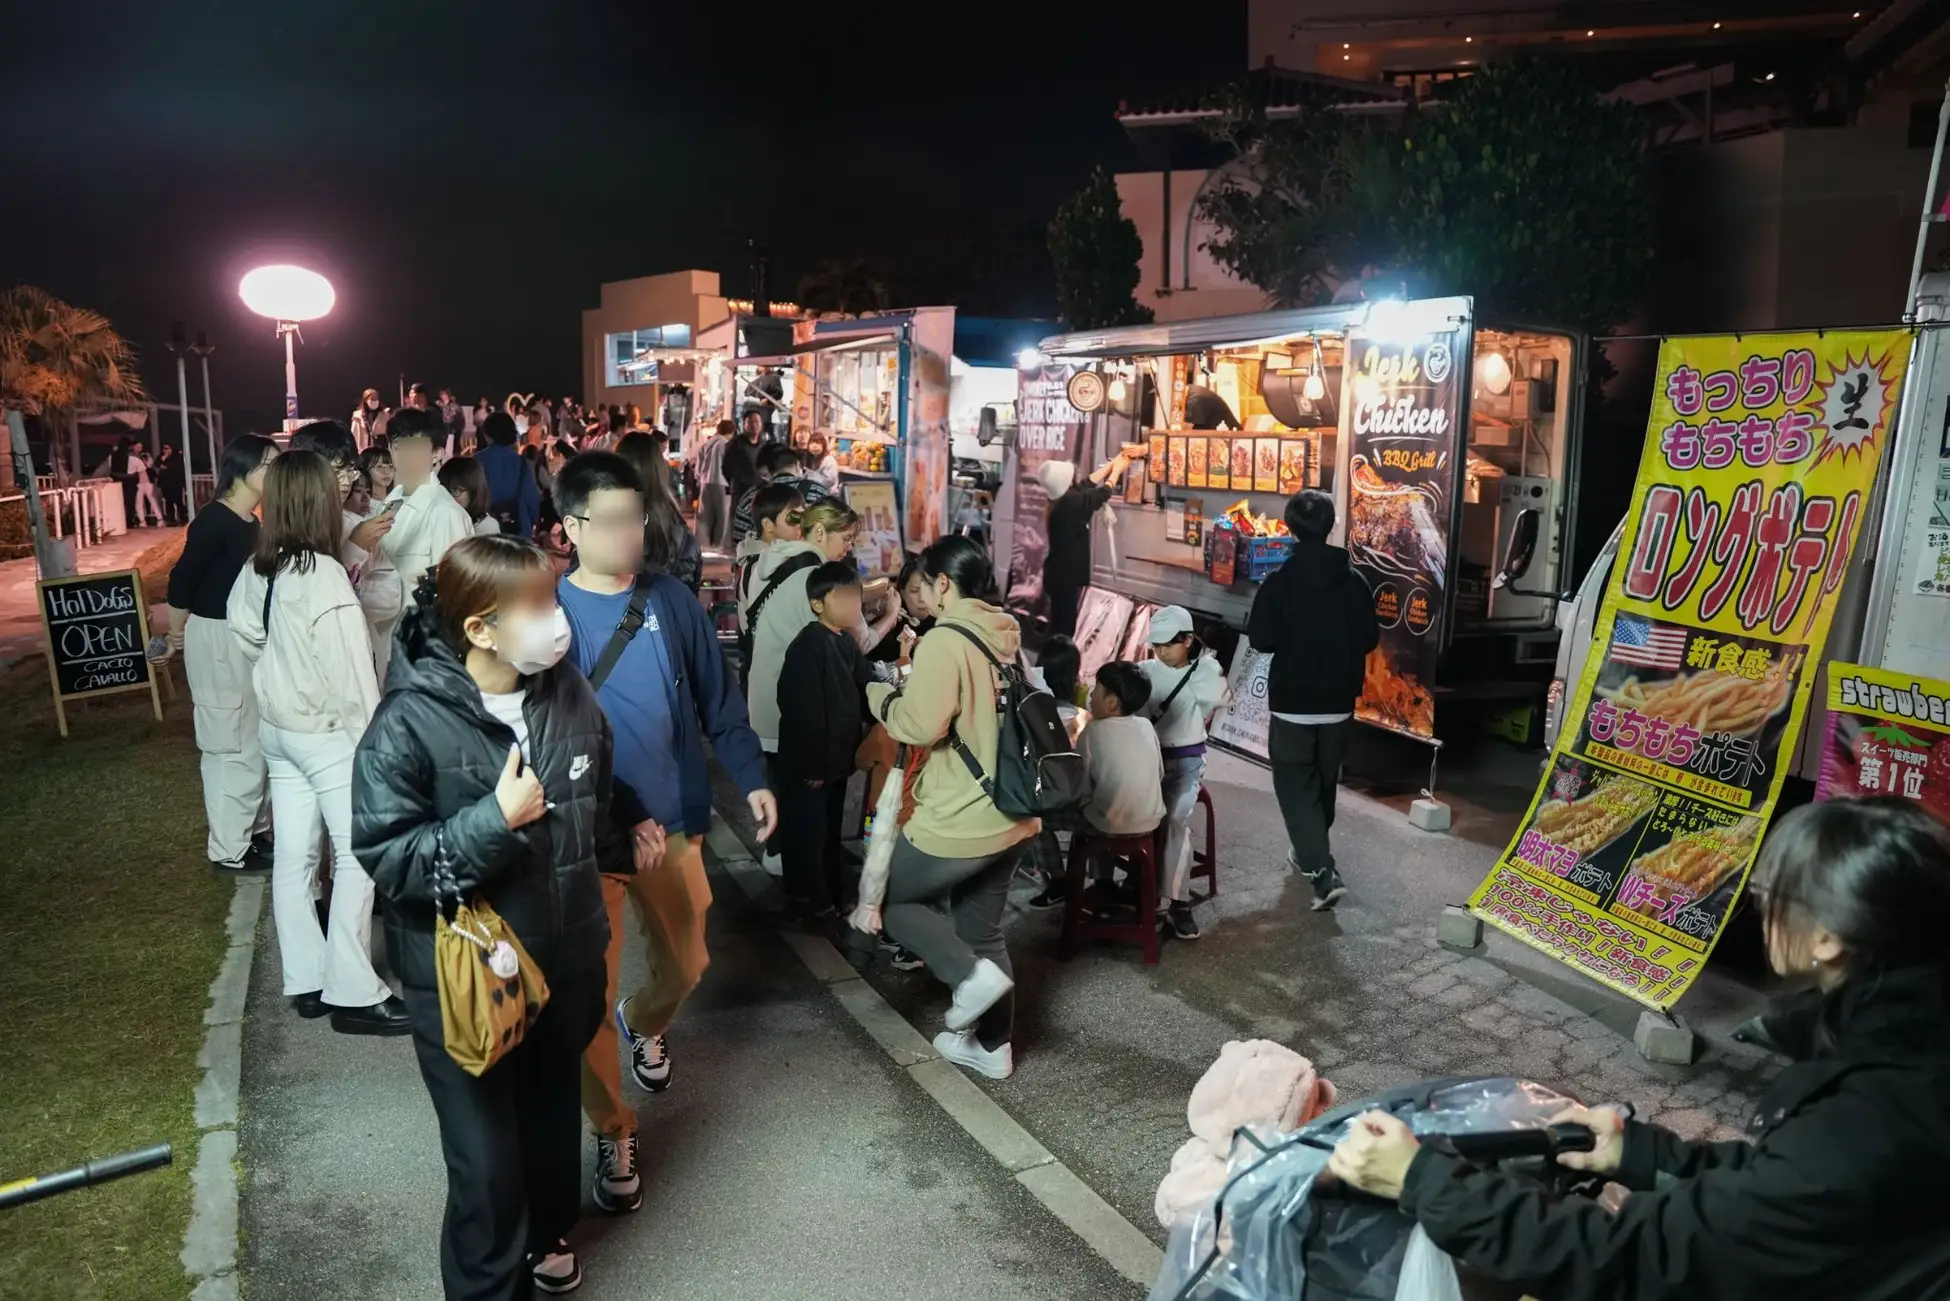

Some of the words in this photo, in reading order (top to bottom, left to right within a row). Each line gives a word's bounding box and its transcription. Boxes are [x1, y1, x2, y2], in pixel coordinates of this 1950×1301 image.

[1665, 347, 1817, 416] もっちり
[1832, 371, 1870, 431] 生
[1353, 394, 1449, 435] Chicken
[1019, 425, 1045, 449] OVER
[1660, 409, 1816, 471] もちもち
[1382, 449, 1411, 471] BBQ
[1411, 450, 1437, 472] Grill
[61, 623, 133, 658] OPEN
[74, 669, 138, 691] CAVALLO
[83, 658, 134, 672] CACIO
[1588, 698, 1766, 788] もちもちポテト
[1858, 756, 1925, 800] 第1位
[1516, 829, 1612, 893] 明太マヨポテト
[1616, 872, 1716, 939] Wチーズポテト
